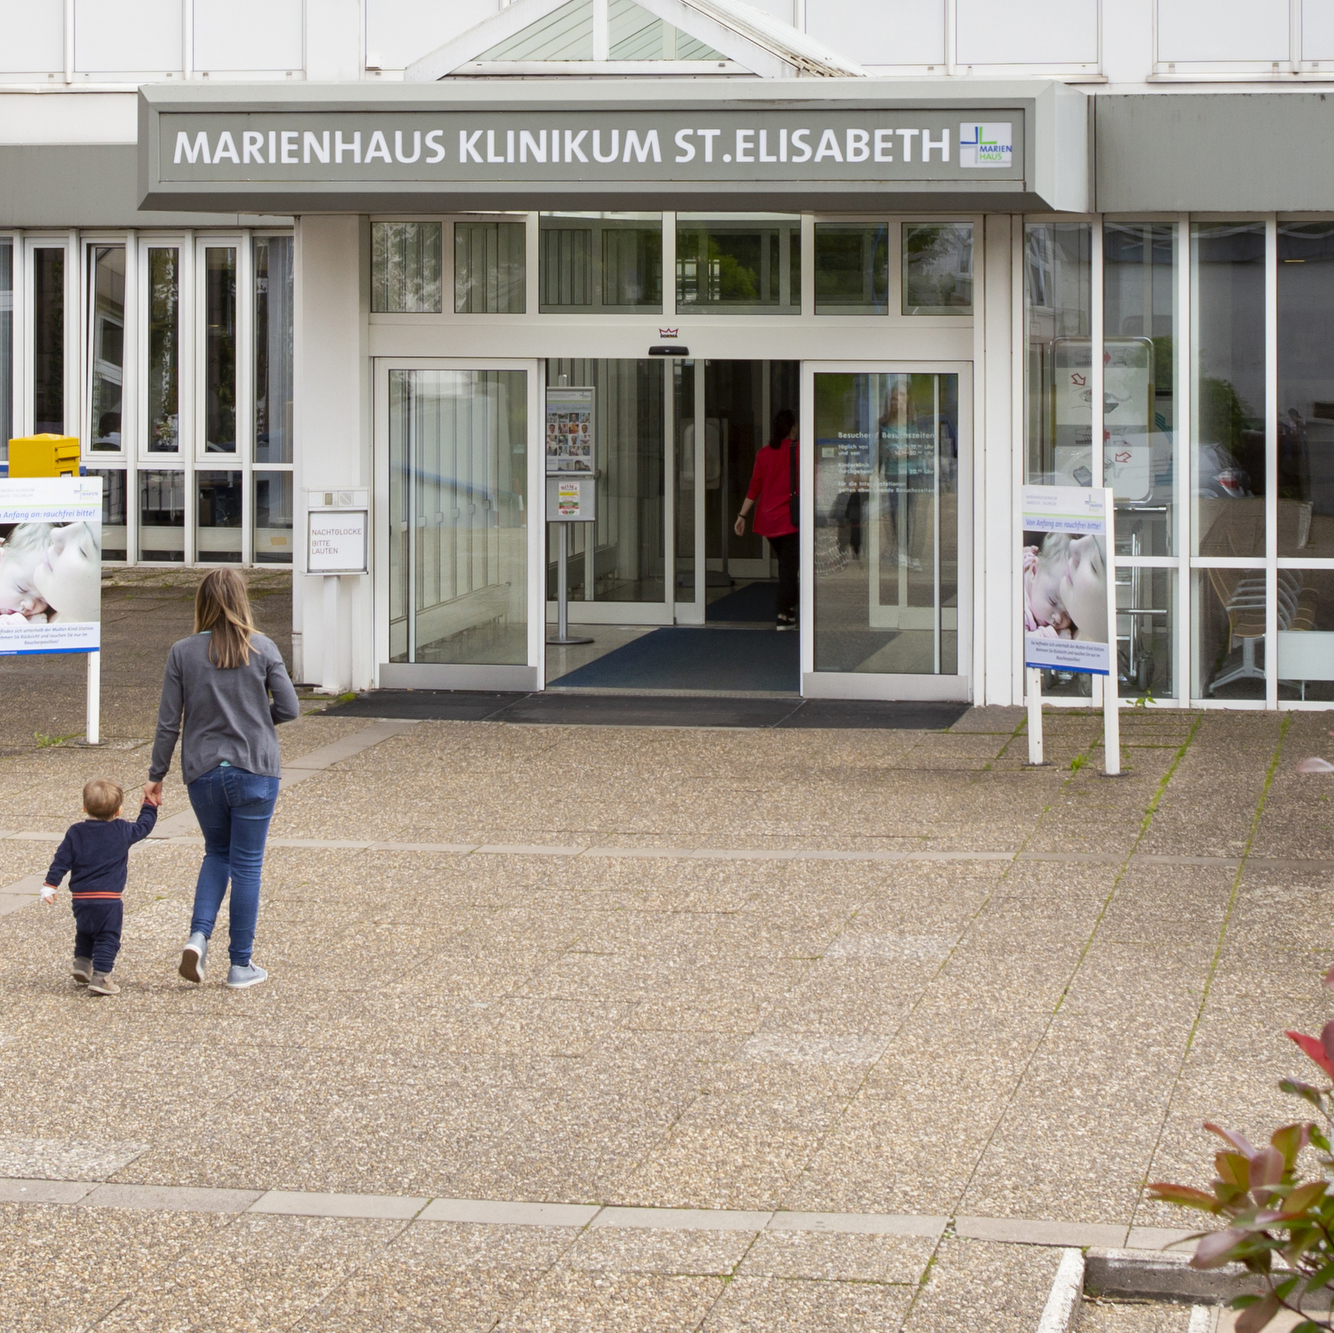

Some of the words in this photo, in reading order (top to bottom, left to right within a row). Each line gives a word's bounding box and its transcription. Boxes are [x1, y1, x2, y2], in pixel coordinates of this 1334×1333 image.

[173, 129, 446, 164] MARIENHAUS
[459, 129, 662, 163] KLINIKUM
[979, 152, 1002, 160] HAUS
[3, 511, 28, 520] Anfang
[43, 510, 75, 519] rauchfrei
[312, 528, 362, 536] NACHTGLOCKE
